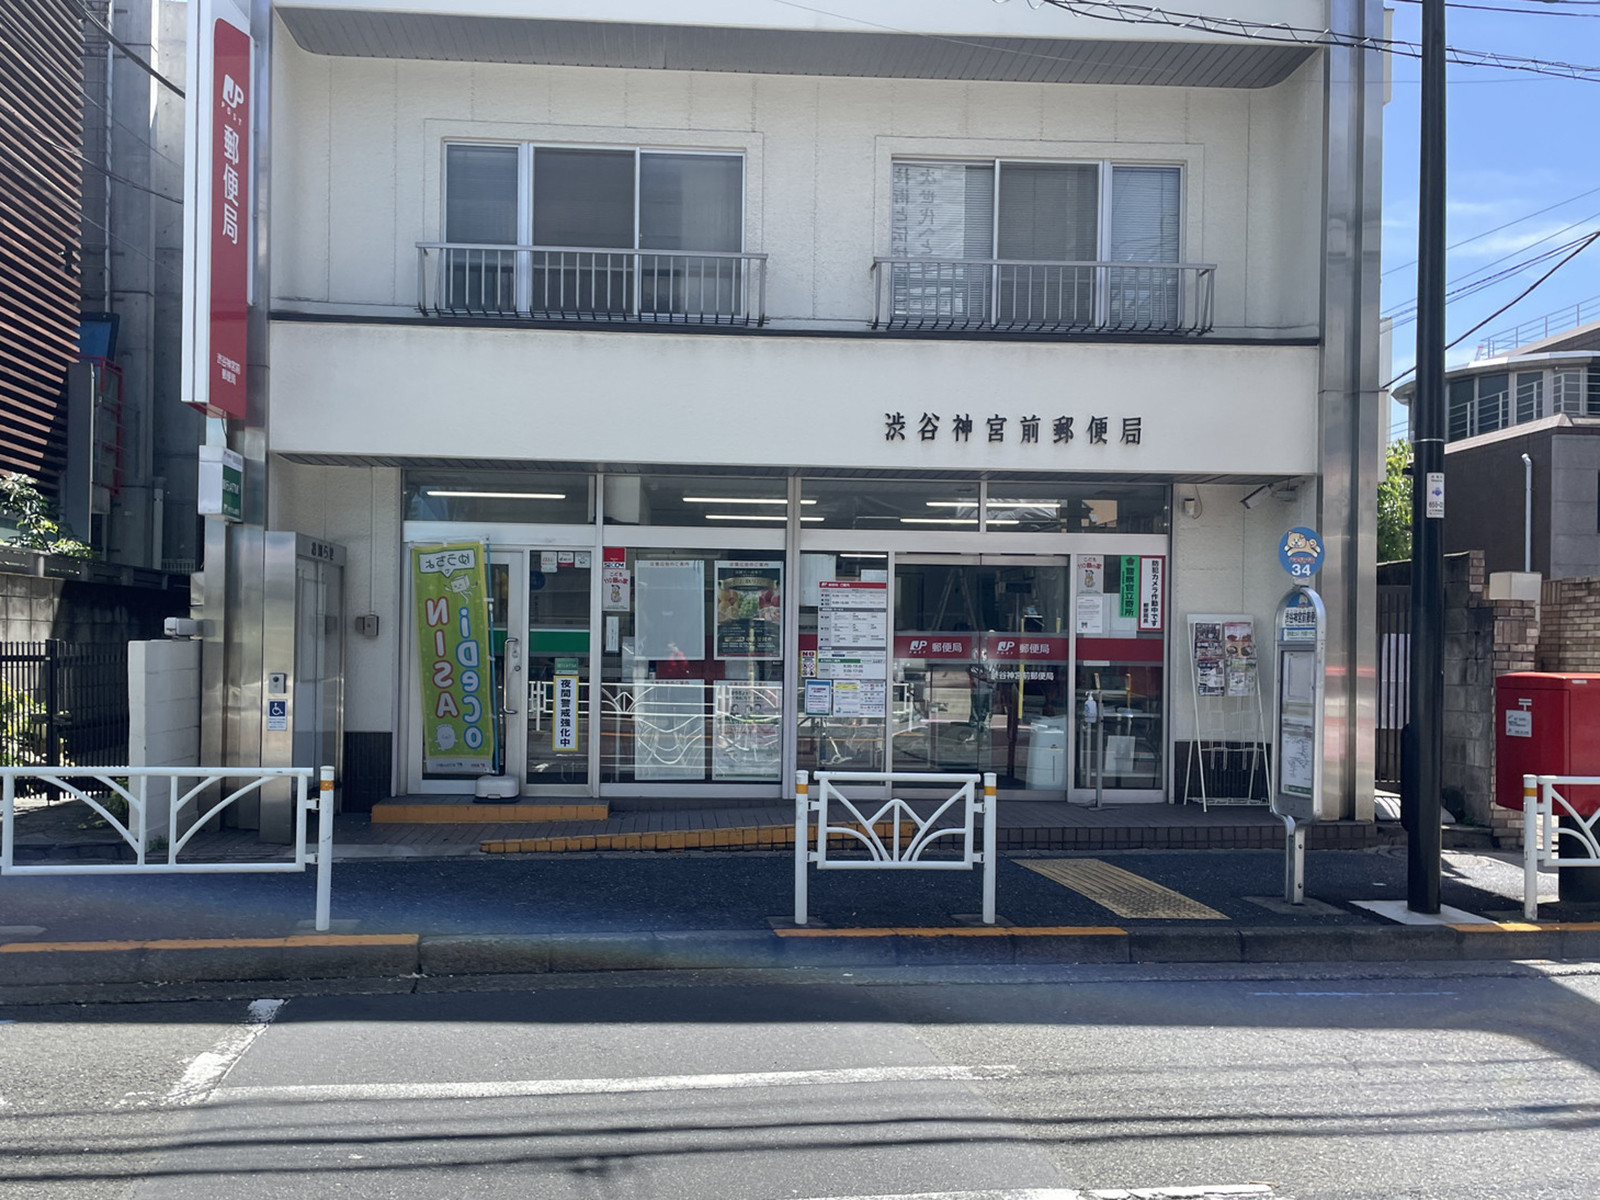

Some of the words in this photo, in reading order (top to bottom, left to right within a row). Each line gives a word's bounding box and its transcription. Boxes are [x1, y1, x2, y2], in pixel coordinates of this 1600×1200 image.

[222, 123, 240, 245] 郵便局
[883, 411, 1142, 445] 渋谷神宮前郵便局
[1291, 563, 1312, 576] 34
[1150, 559, 1160, 627] 防犯カメラ作動中です
[931, 642, 963, 653] 郵便局
[1019, 643, 1050, 654] 郵便局
[560, 679, 571, 747] 夜間警戒強化中
